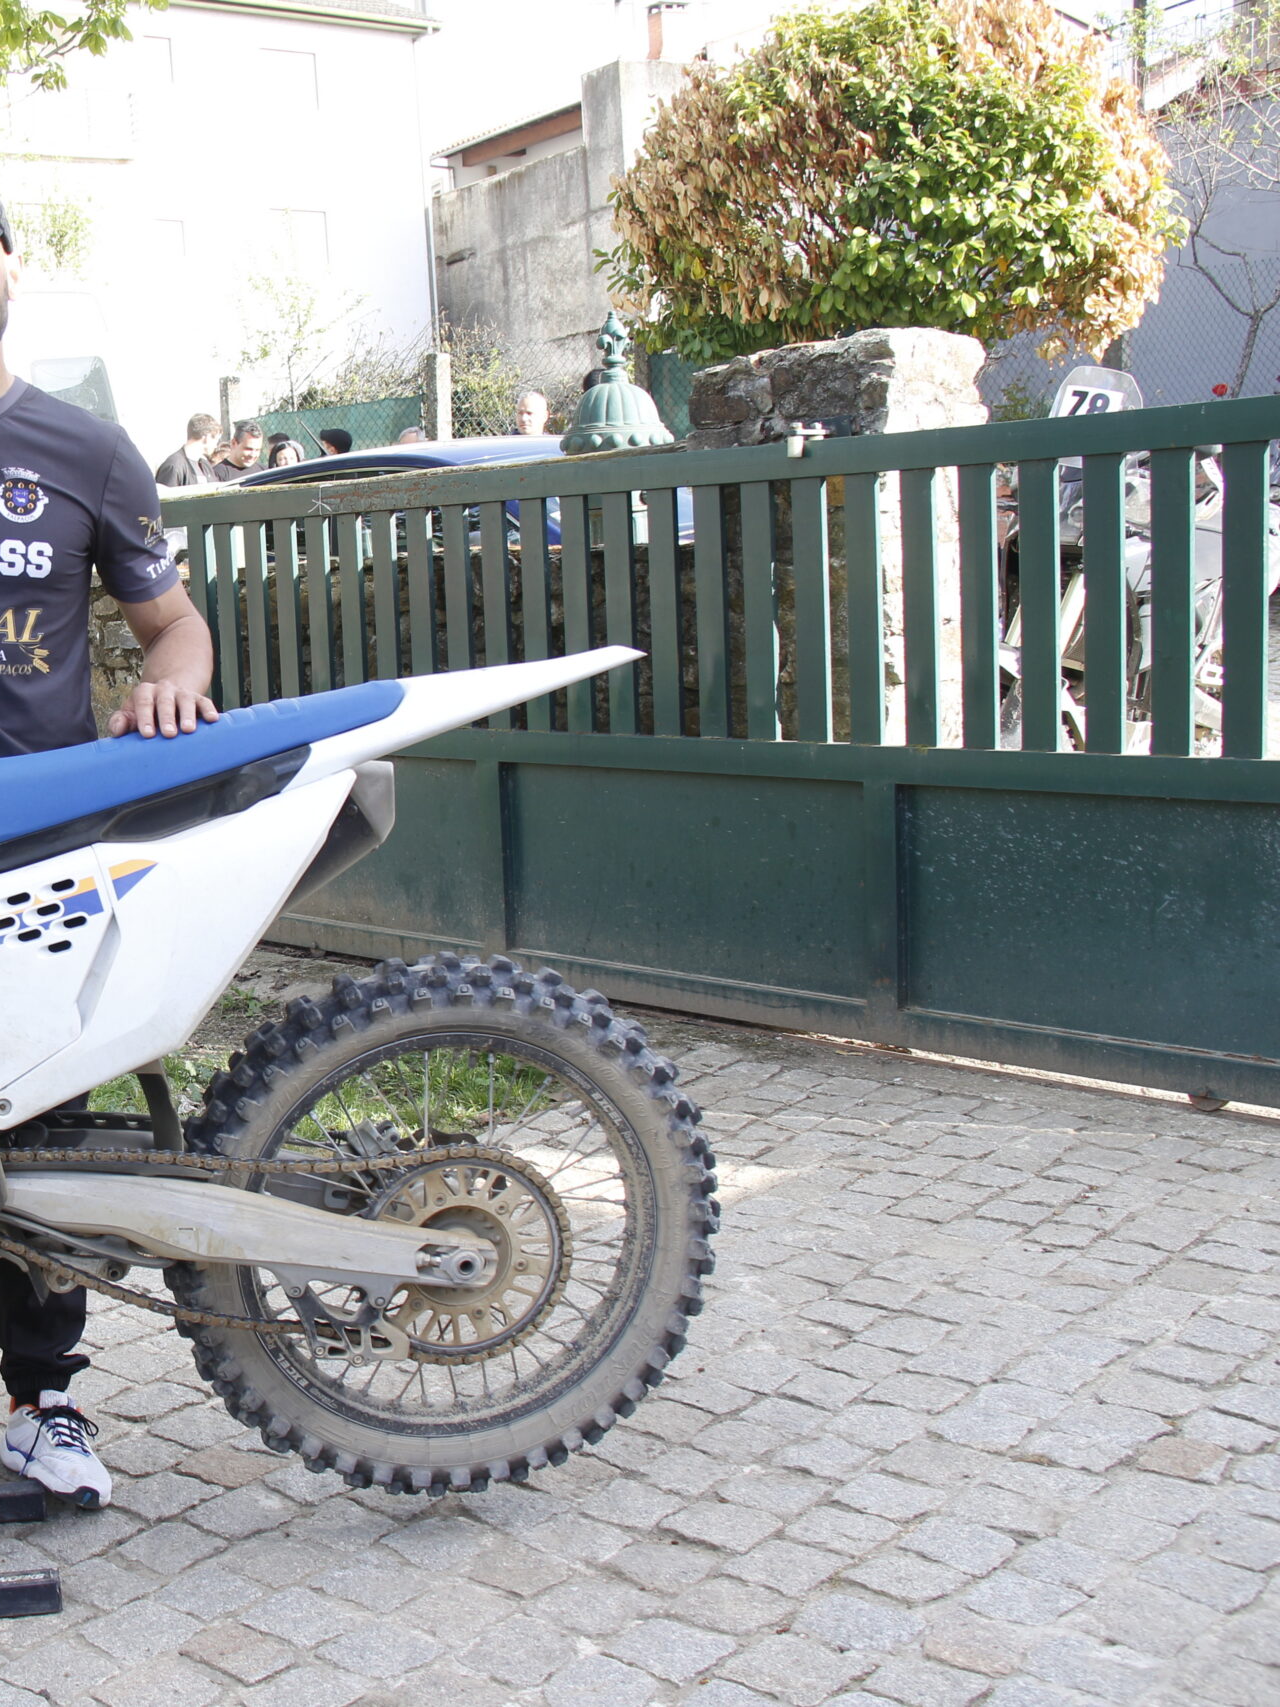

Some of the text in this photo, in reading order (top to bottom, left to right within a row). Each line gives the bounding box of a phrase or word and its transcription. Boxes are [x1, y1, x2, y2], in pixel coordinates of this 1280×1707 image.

[1068, 390, 1110, 416] 78
[591, 1092, 622, 1127] EXCEL
[277, 1353, 310, 1388] EXCEL
